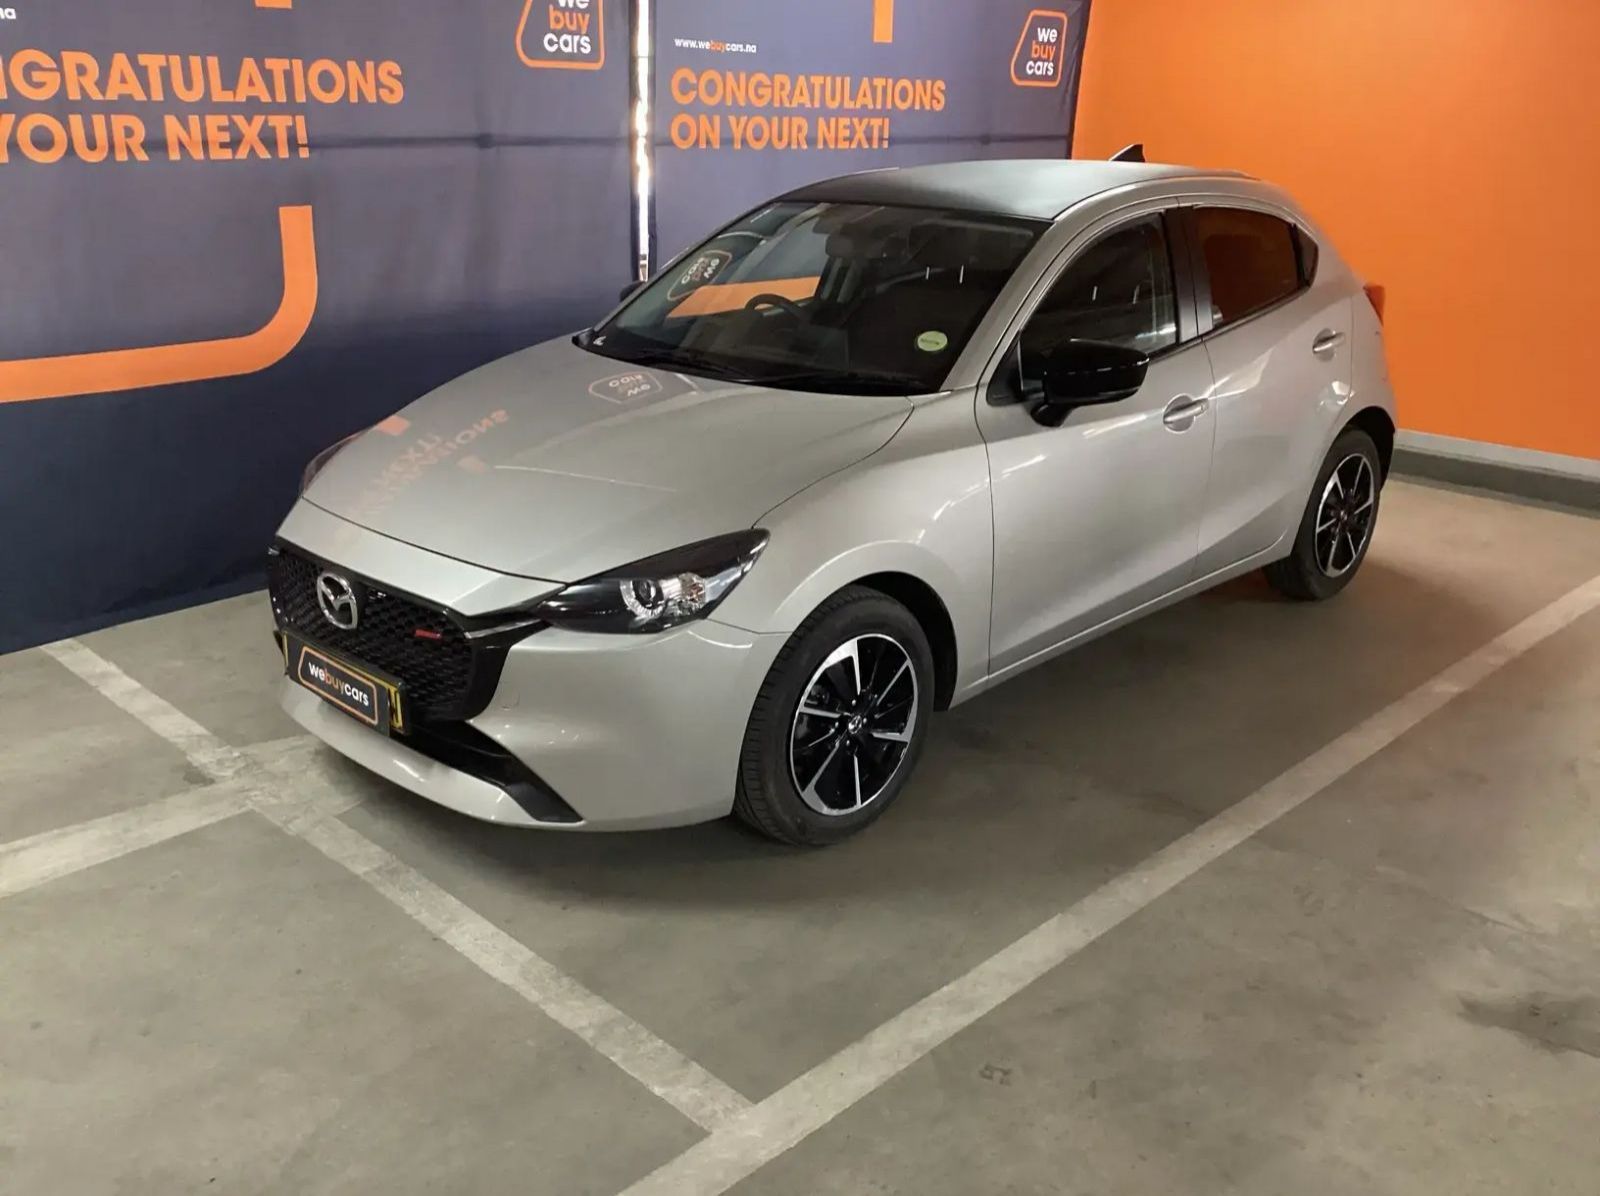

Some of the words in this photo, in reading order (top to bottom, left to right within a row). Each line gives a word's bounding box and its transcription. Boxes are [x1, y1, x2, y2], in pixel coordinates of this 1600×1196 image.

[548, 4, 590, 34] buy
[543, 33, 592, 54] cars
[673, 38, 757, 54] www.webuycars.na
[1037, 27, 1058, 43] we
[1031, 40, 1056, 61] buy
[0, 48, 404, 104] GRATULATIONS
[1025, 60, 1054, 76] cars
[670, 67, 946, 112] CONGRATULATIONS
[164, 114, 310, 162] NEXT!
[670, 112, 721, 150] ON
[728, 115, 808, 150] YOUR
[817, 116, 890, 150] NEXT!
[308, 661, 369, 707] webuycars
